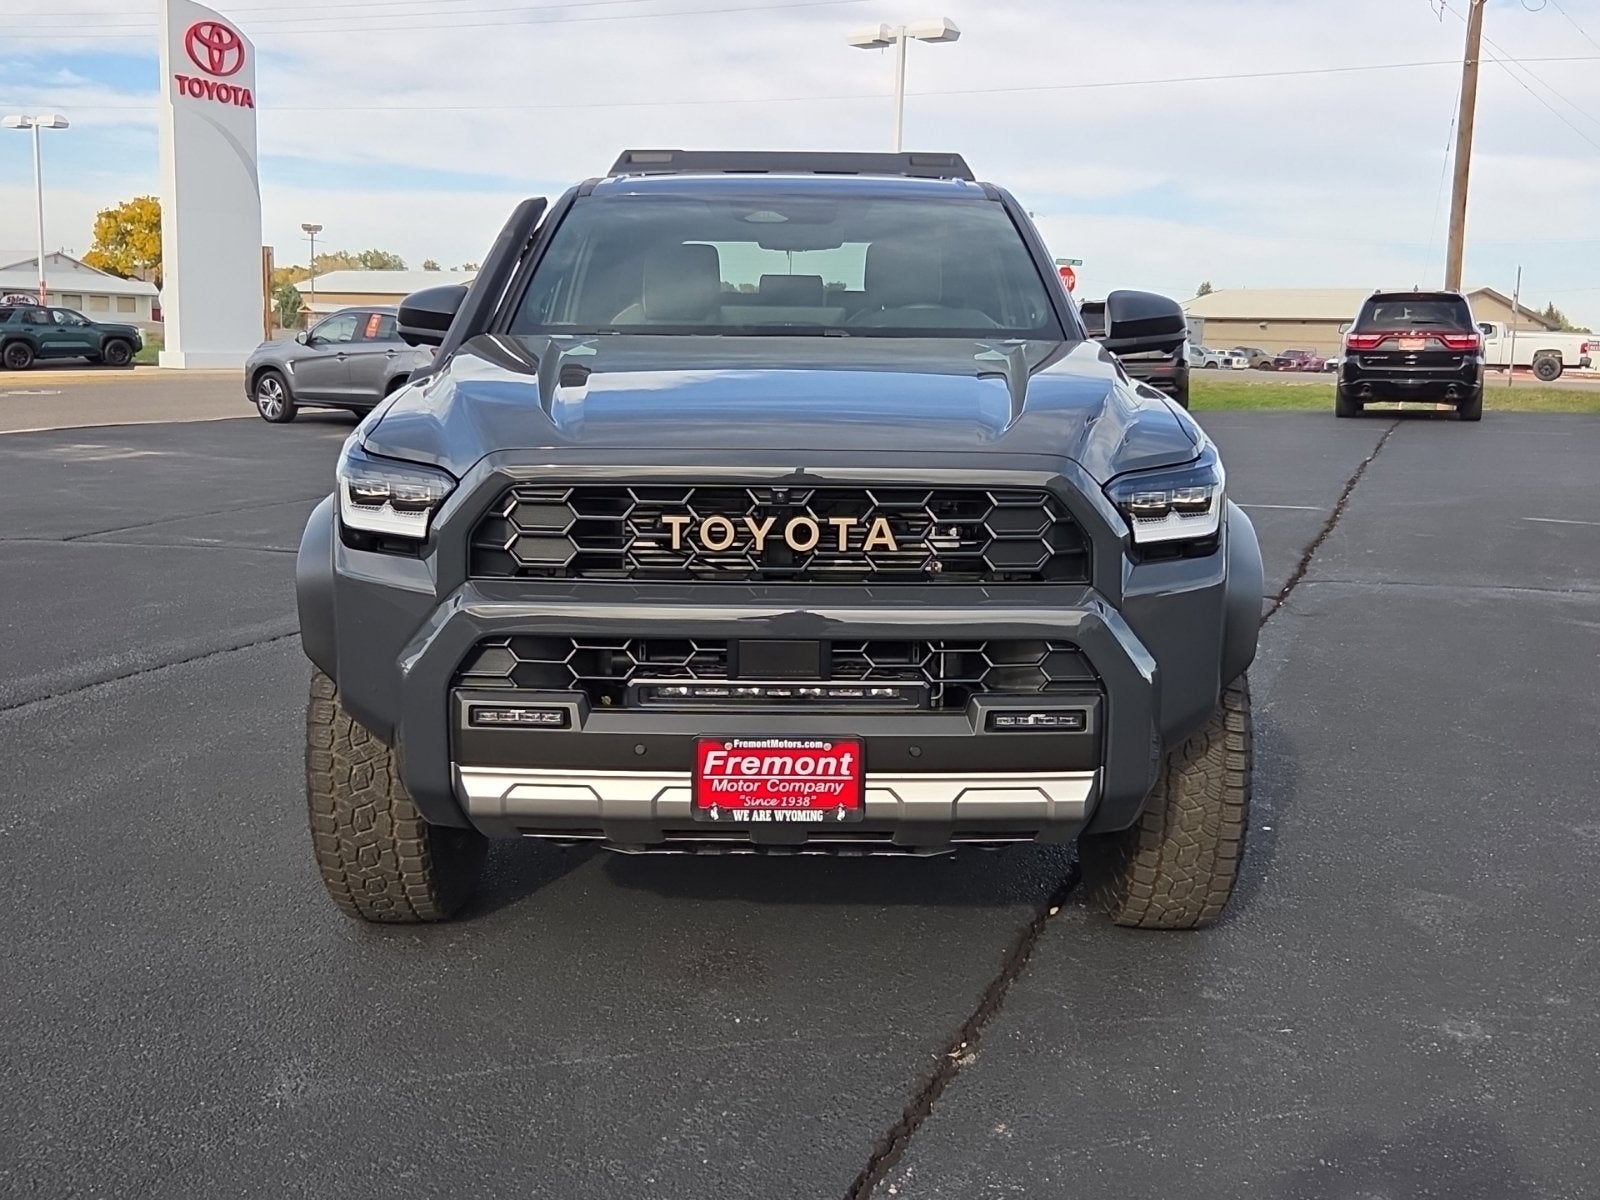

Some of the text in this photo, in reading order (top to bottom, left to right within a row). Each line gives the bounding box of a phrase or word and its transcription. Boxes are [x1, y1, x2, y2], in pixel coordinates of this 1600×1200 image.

[174, 74, 254, 109] TOYOTA
[661, 515, 898, 551] TOYOTA
[733, 739, 823, 749] FremontMotors.com
[703, 750, 853, 775] Fremont
[711, 779, 844, 795] Motor Company
[732, 809, 824, 822] WE ARE WYOMING
